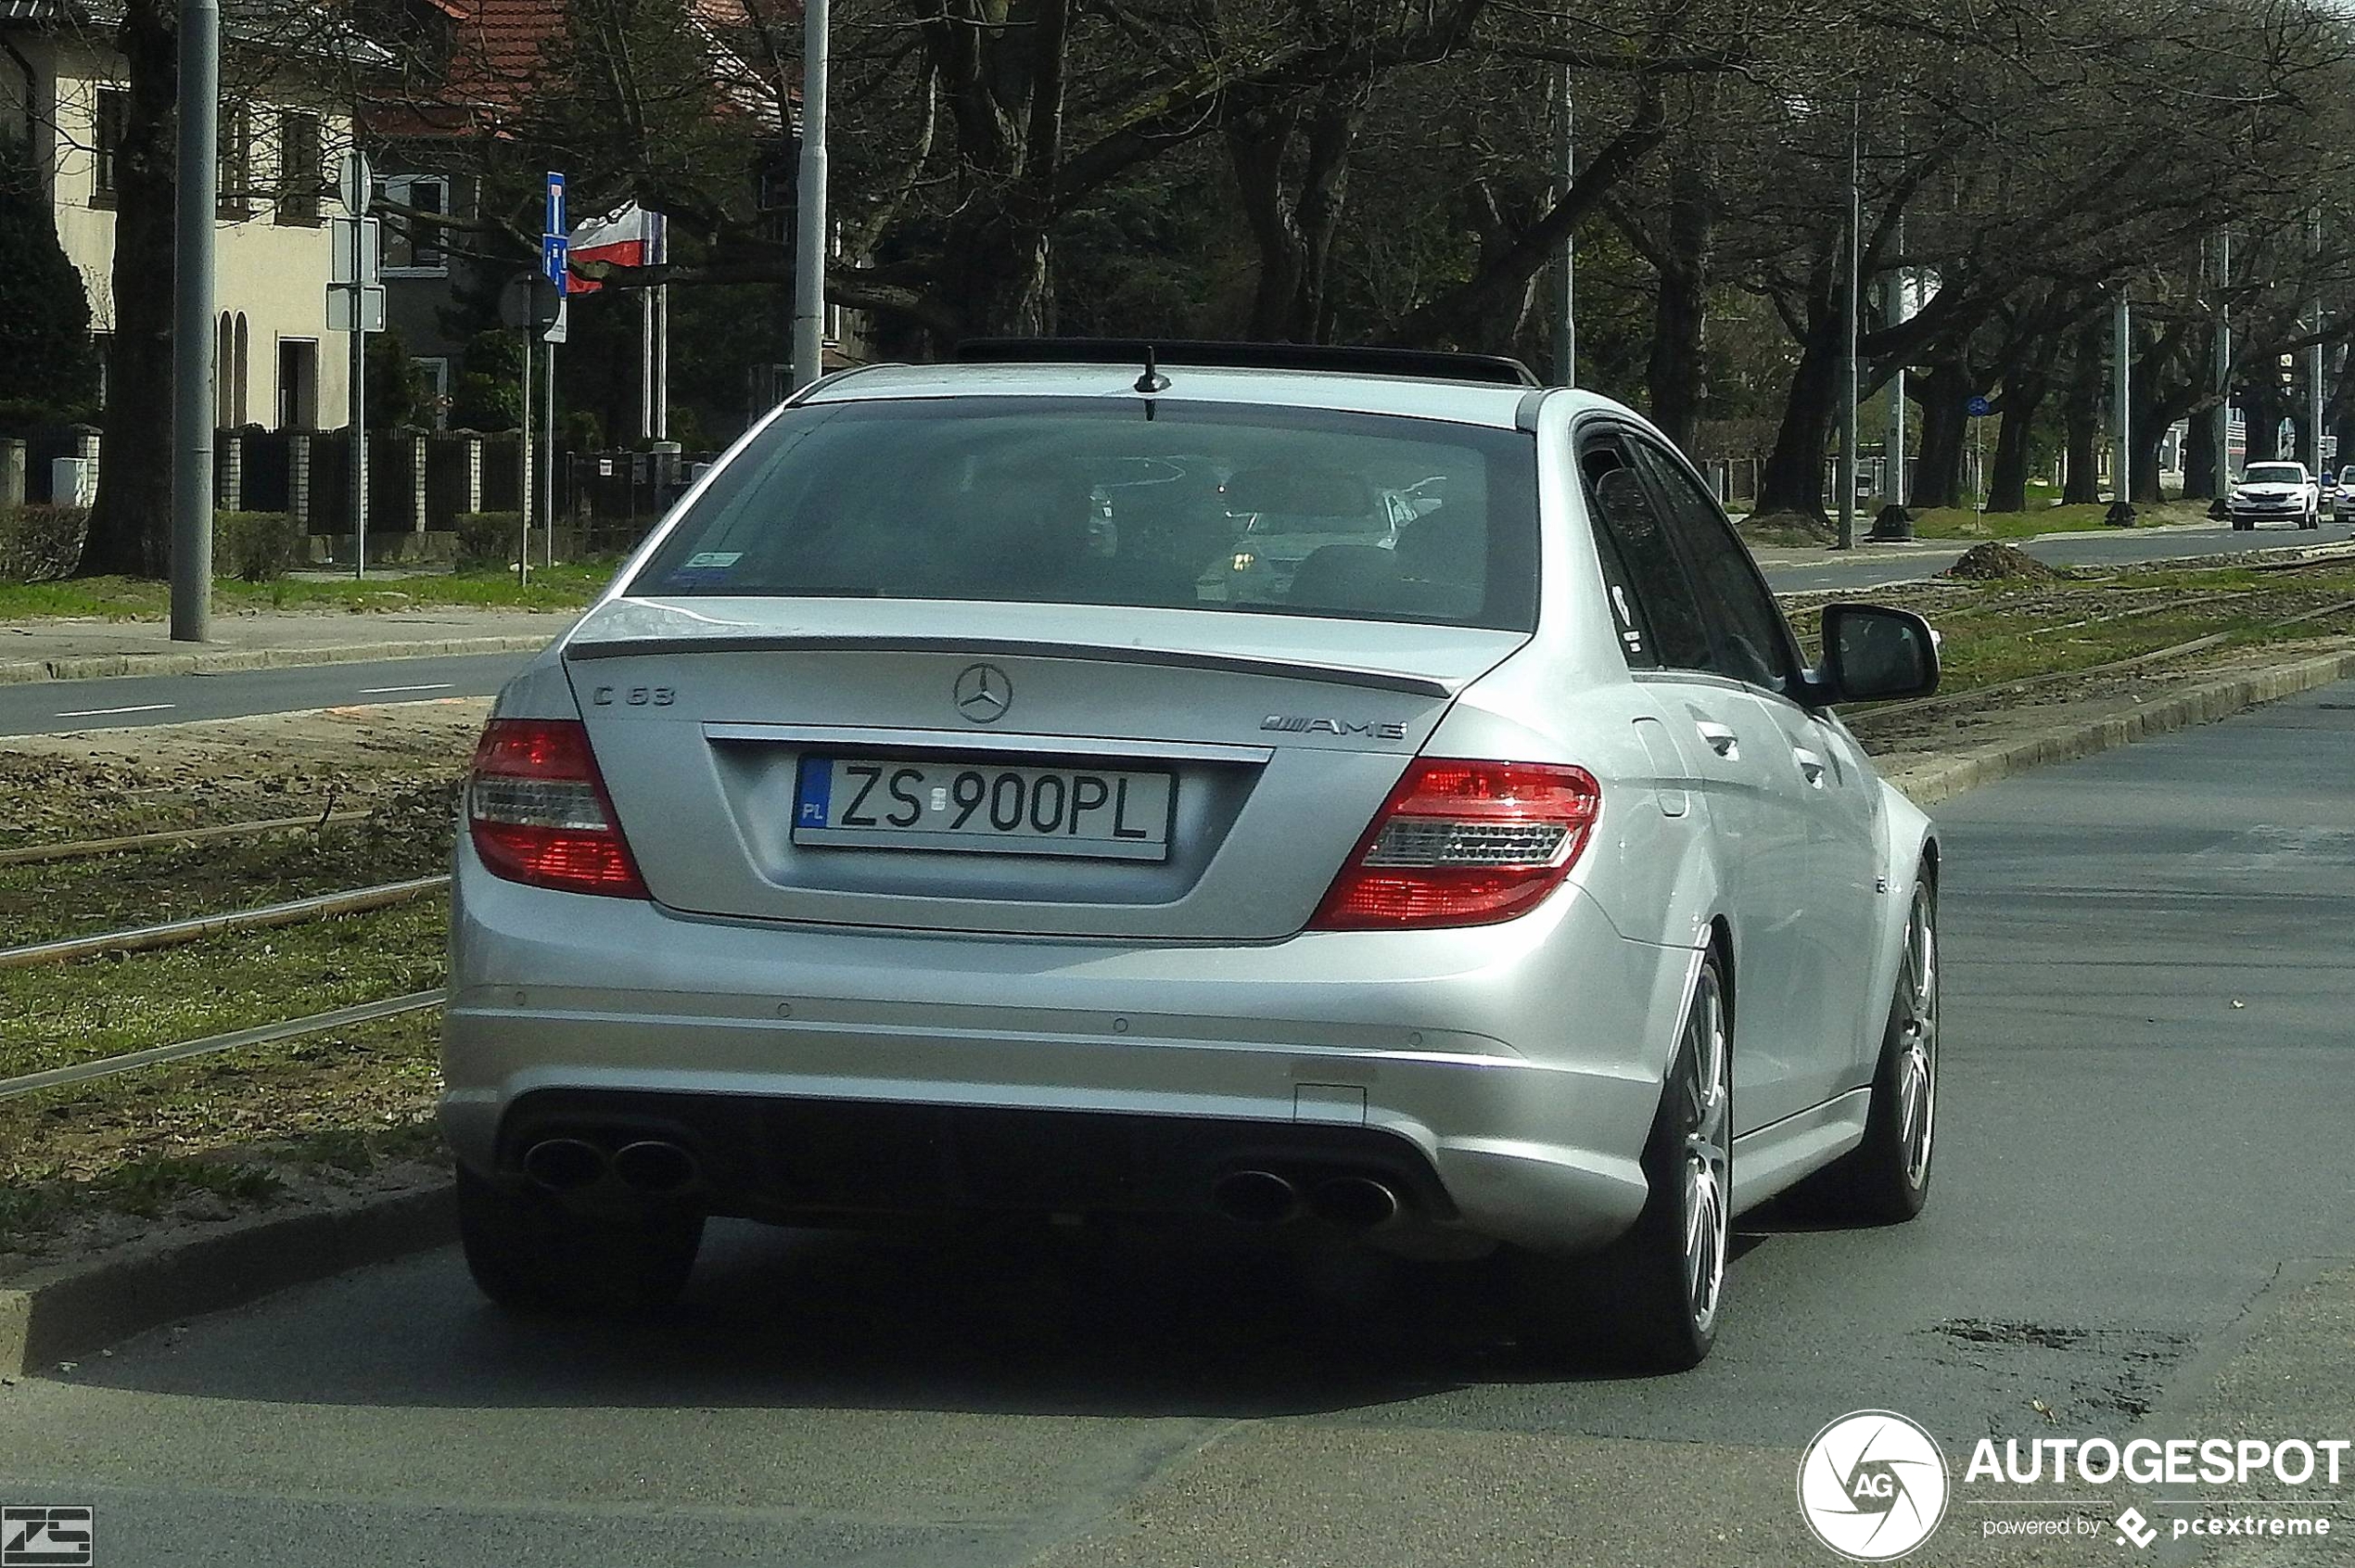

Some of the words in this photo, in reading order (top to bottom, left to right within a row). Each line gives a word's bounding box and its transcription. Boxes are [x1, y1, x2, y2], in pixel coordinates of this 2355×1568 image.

[593, 686, 614, 706] C
[626, 687, 675, 706] 63
[802, 803, 823, 821] PL
[841, 766, 925, 827] ZS
[950, 771, 1147, 838] 900PL
